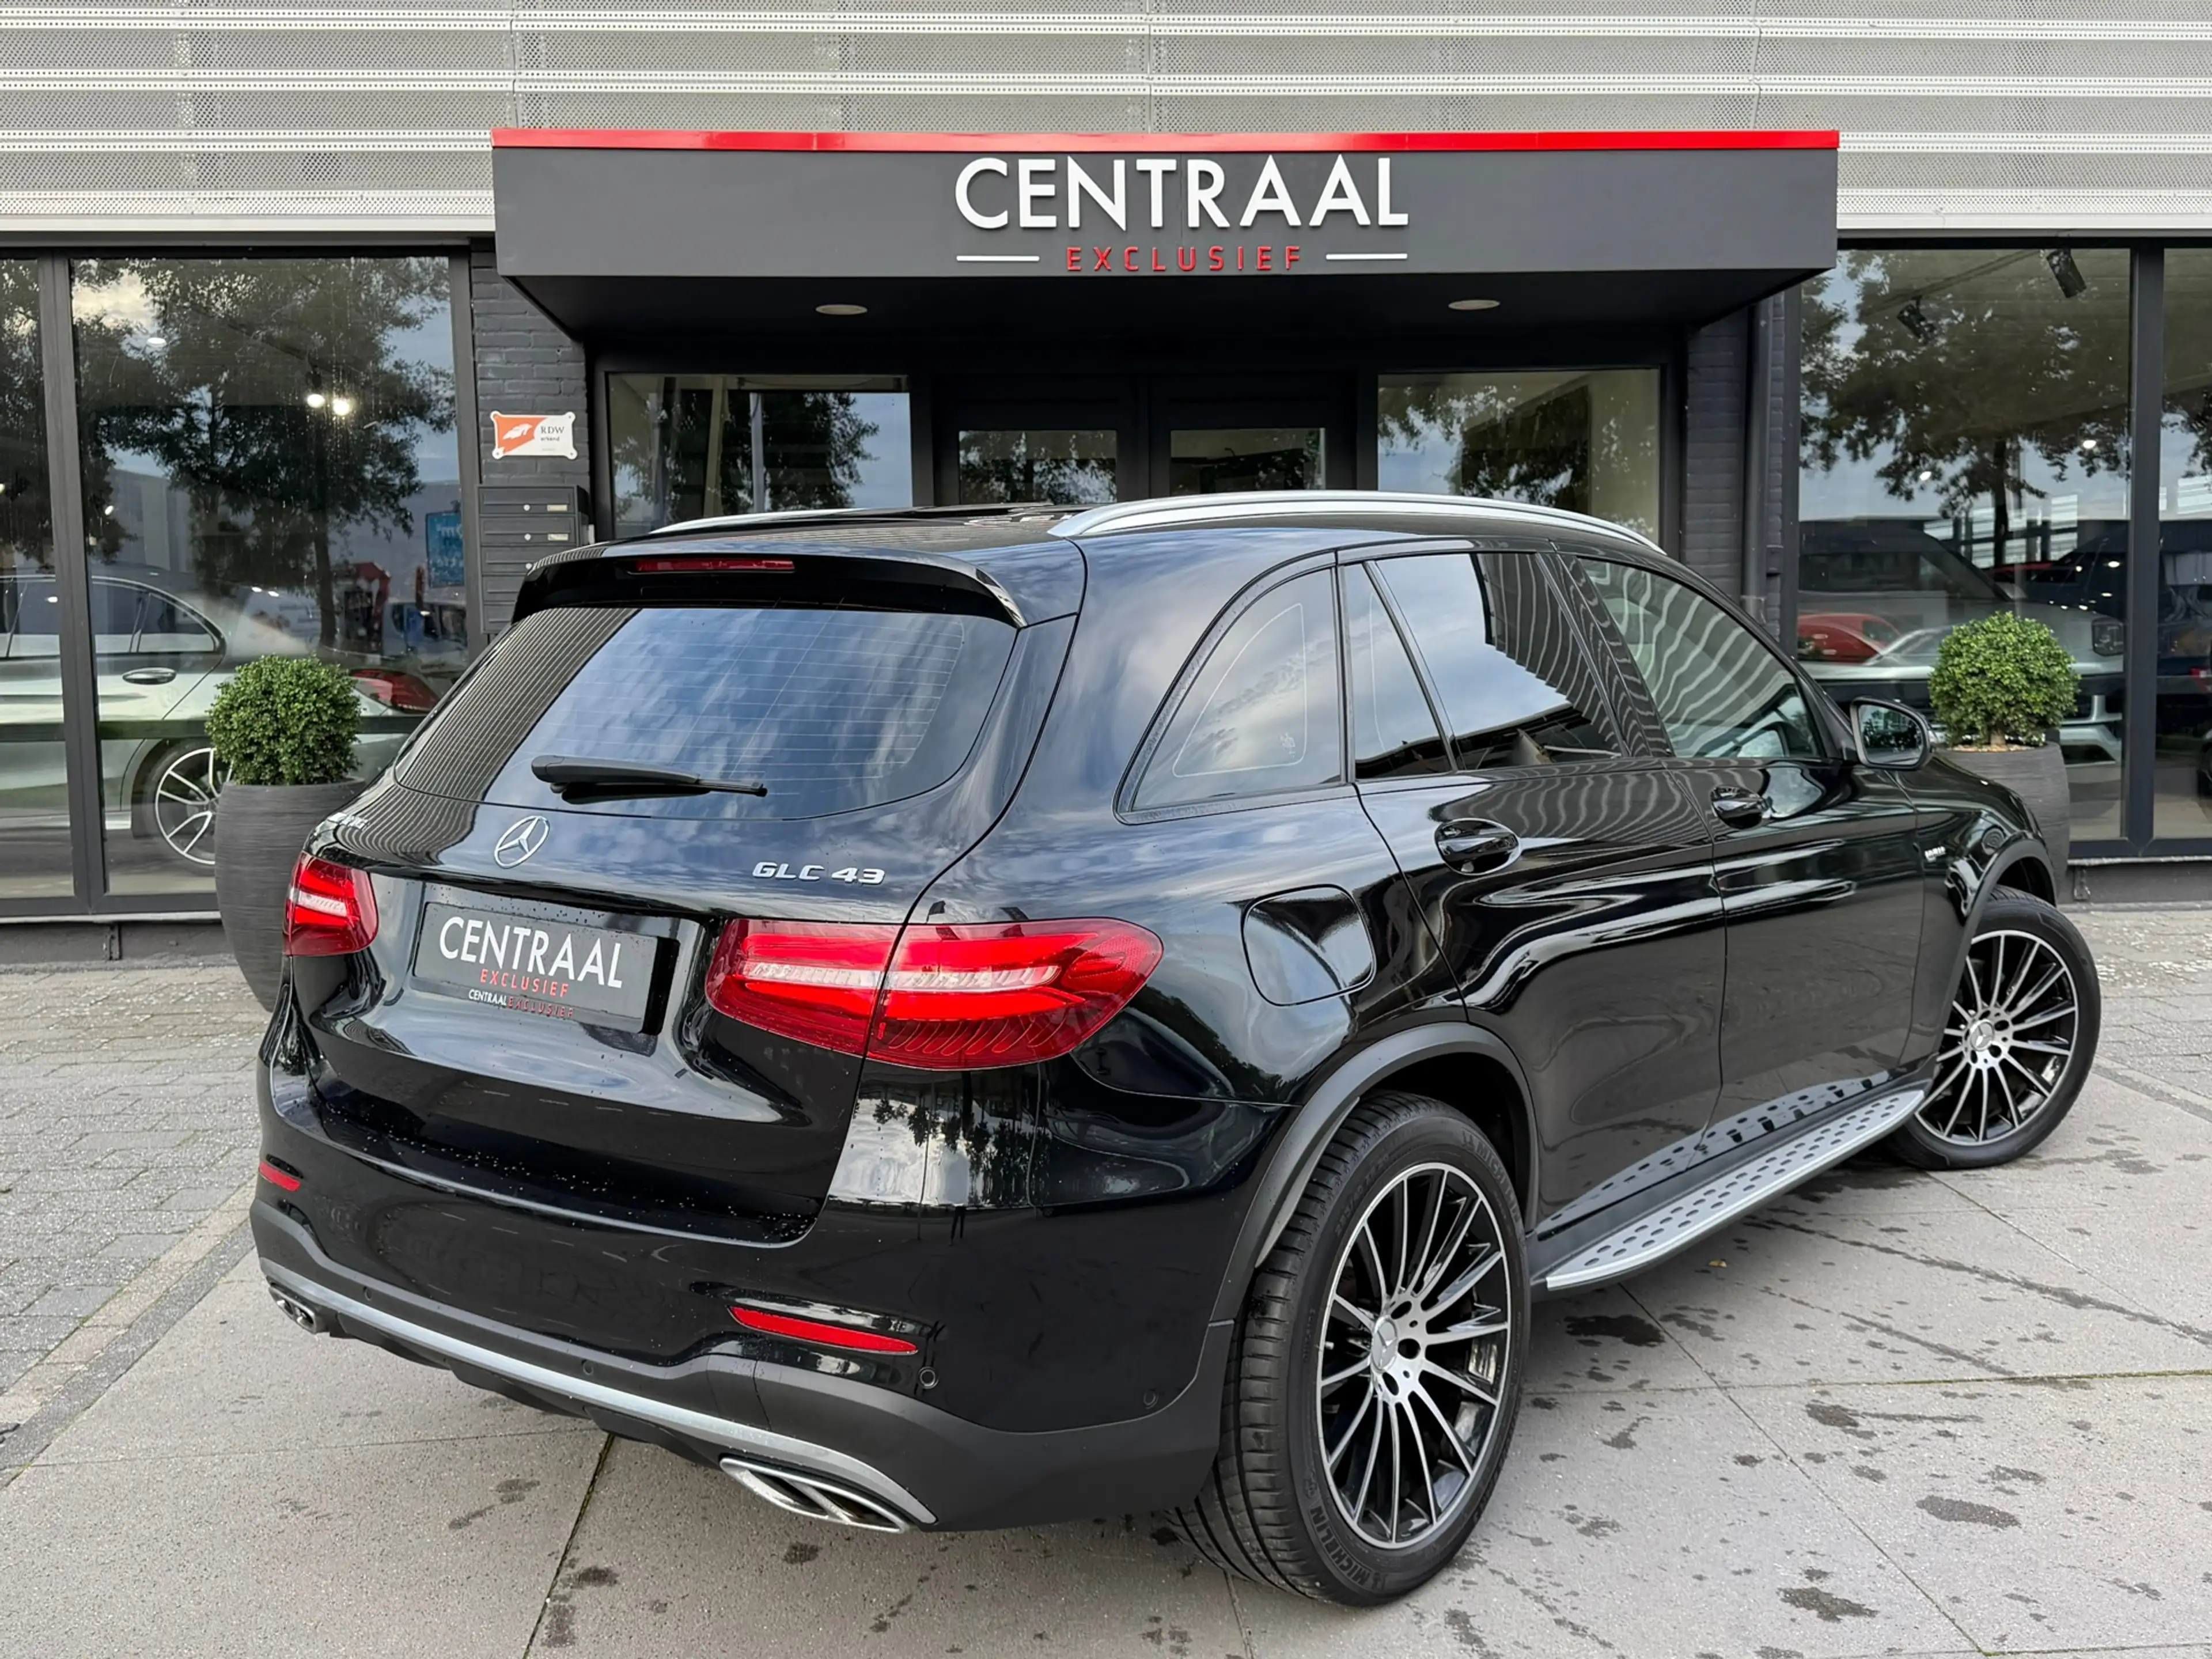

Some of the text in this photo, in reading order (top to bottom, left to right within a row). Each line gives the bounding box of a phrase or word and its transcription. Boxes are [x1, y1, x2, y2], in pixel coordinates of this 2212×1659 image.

[955, 154, 1409, 230] CENTRAAL
[1066, 245, 1302, 272] EXCLUSIEF
[540, 426, 565, 434] RDW
[752, 861, 885, 885] GLC 43
[440, 916, 623, 988] CENTRAAL
[480, 968, 570, 998] EXCLUSIEF
[468, 989, 574, 1018] CENTRAAL EXCLUSIEF
[1309, 1505, 1372, 1586] MICHELIN
